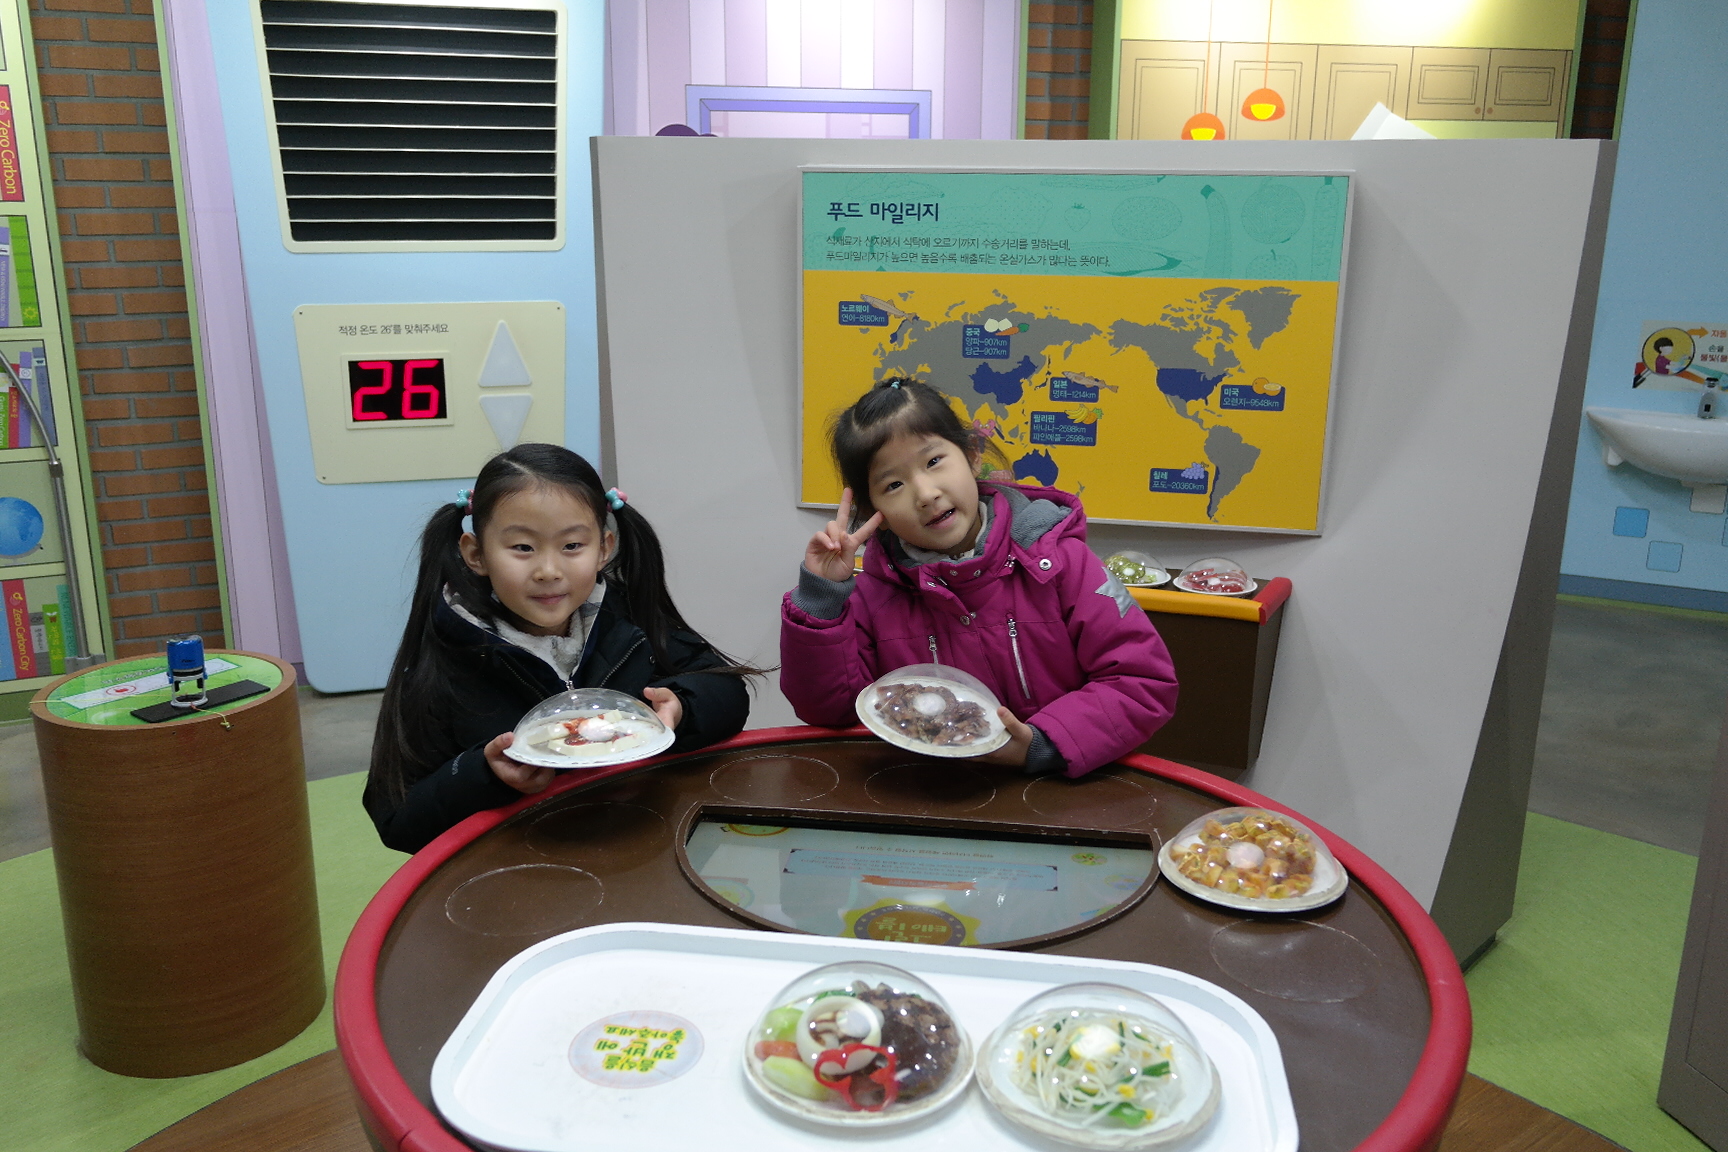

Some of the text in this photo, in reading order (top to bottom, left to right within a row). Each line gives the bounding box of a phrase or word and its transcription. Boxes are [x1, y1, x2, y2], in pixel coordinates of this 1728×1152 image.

[1, 149, 18, 194] Carbon
[827, 202, 939, 224] 푸드 마일리지
[826, 235, 1071, 251] 식재료가 산지에서 식탁에 오르기까지 수송거리를 말하는데,
[826, 251, 1111, 267] 푸드마일리지가 높으면 높을수록 배출되는 온실가스가 많다는 뜻이다.
[841, 304, 870, 313] 노르웨이
[338, 325, 357, 336] 적정
[359, 324, 378, 336] 온도
[404, 323, 449, 335] 맞춰주세요
[965, 327, 981, 336] 중국
[353, 360, 440, 420] 26
[1052, 380, 1068, 389] 일본
[1223, 387, 1240, 397] 미국
[1033, 414, 1055, 423] 필리핀
[1152, 470, 1169, 480] 칠레
[13, 608, 30, 671] Zero Carbon City
[875, 916, 947, 932] 테이블
[604, 1026, 684, 1044] 놓아주세요
[596, 1039, 677, 1059] 쟁반에
[604, 1054, 655, 1073] 음식을
